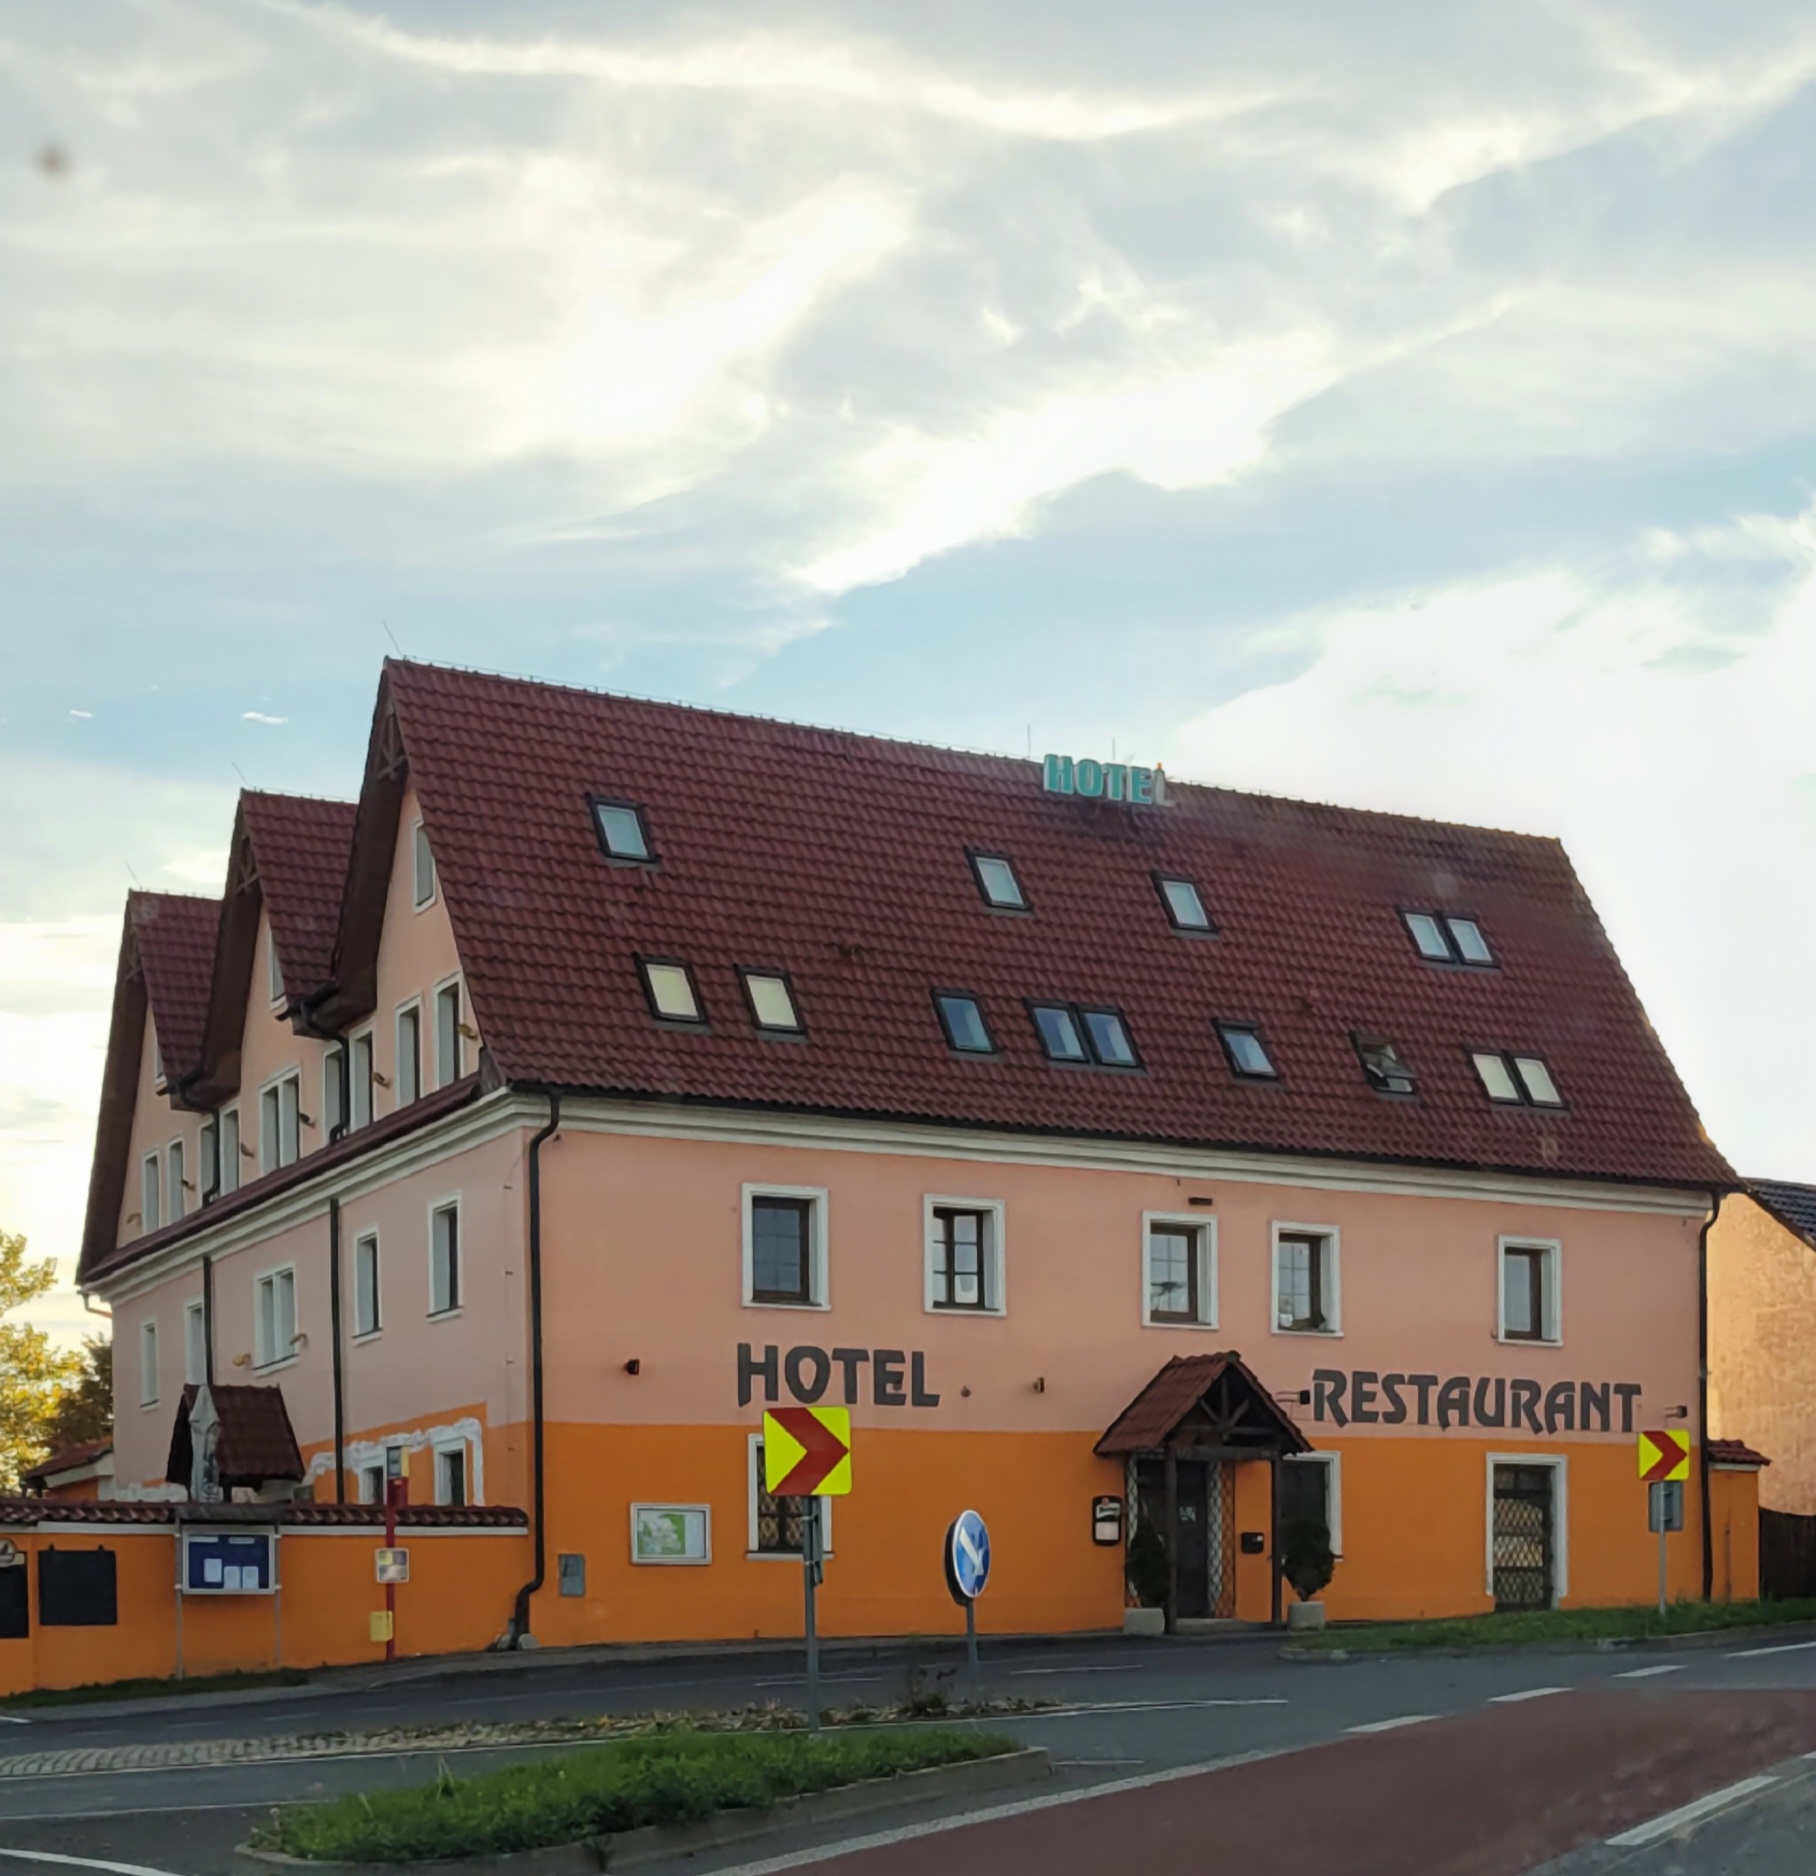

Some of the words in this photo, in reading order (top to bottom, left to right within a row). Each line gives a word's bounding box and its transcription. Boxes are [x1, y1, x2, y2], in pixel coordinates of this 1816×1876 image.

[1043, 753, 1177, 807] HOTEL
[737, 1343, 940, 1407] HOTEL
[1312, 1369, 1642, 1435] RESTAURANT
